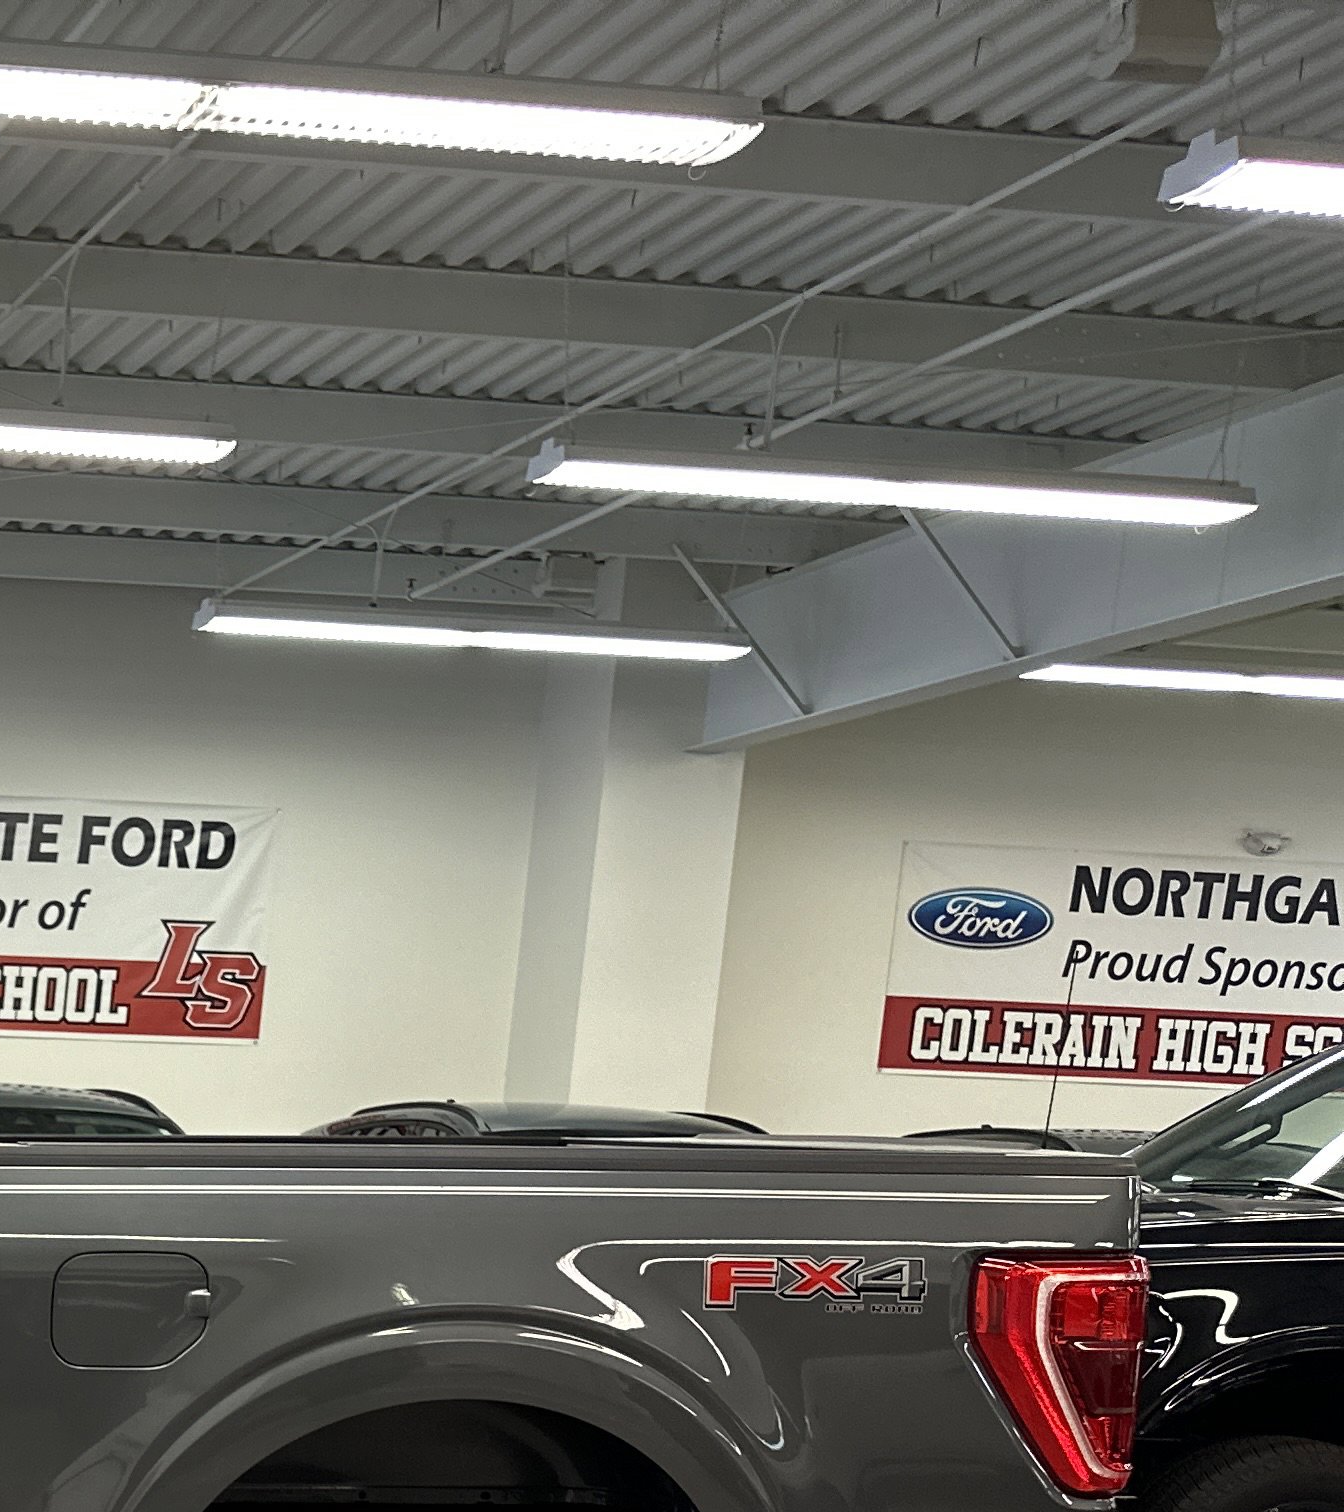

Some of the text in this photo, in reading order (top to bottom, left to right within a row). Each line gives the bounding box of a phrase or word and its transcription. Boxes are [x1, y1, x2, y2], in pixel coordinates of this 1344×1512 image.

[77, 816, 236, 870] FORD
[38, 888, 92, 931] of
[933, 895, 1029, 940] Ford
[1068, 864, 1341, 927] NORTHGA
[1061, 939, 1195, 984] Proud
[910, 1006, 1142, 1071] COLERAIN
[1152, 1018, 1272, 1076] HIGH
[703, 1254, 928, 1310] FX4
[825, 1304, 923, 1315] OFF ROAD
